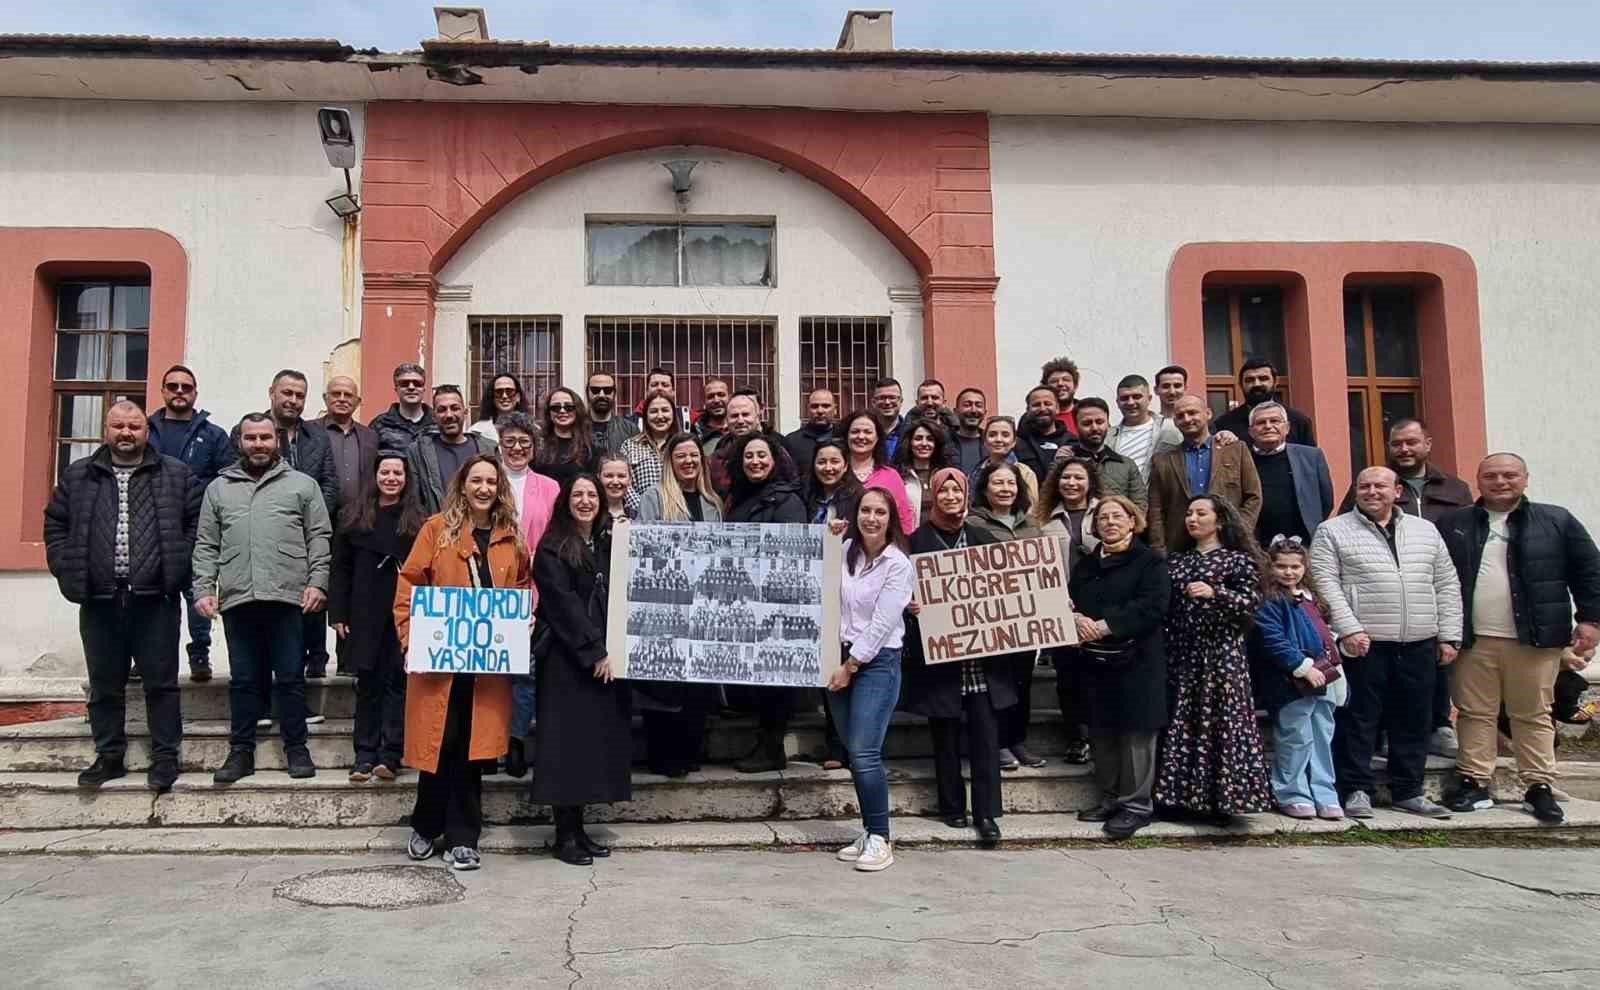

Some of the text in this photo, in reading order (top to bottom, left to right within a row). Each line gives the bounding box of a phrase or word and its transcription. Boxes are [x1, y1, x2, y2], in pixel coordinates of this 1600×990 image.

[916, 537, 1056, 578] ALTINORDU
[412, 587, 531, 620] ALTINORDU
[951, 594, 1036, 628] OKULU
[444, 618, 493, 648] 100
[927, 618, 1066, 660] MEZUNLARI
[428, 647, 509, 672] YAŞINDA
